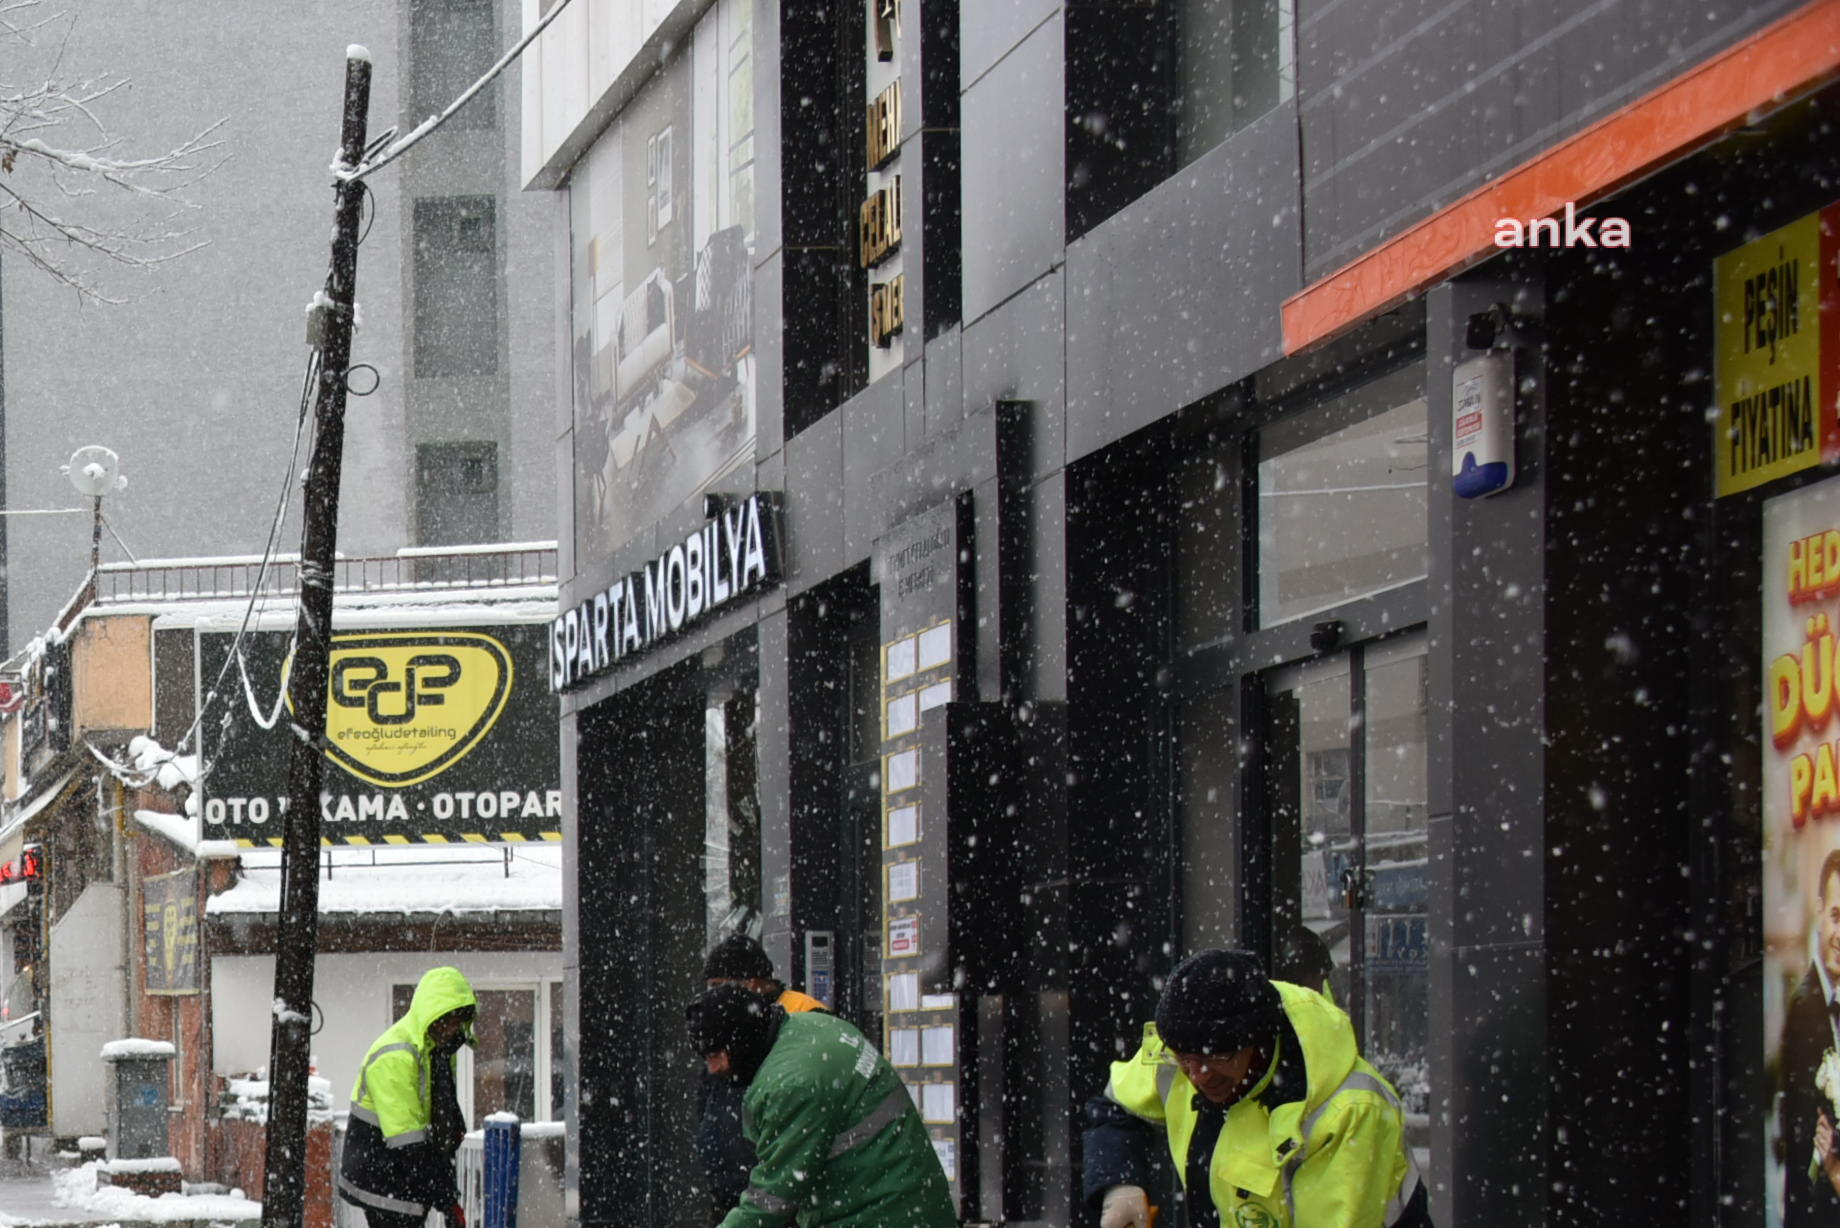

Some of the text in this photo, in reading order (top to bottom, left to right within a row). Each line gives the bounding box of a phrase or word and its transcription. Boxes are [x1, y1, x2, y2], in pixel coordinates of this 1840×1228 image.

[1743, 244, 1799, 365] PEŞİN
[1731, 375, 1814, 477] FİYATINA
[549, 496, 766, 694] ISPARTA MOBİLYA
[1770, 612, 1840, 750] DÜ
[205, 796, 270, 825] OTO
[1787, 741, 1840, 829] PA
